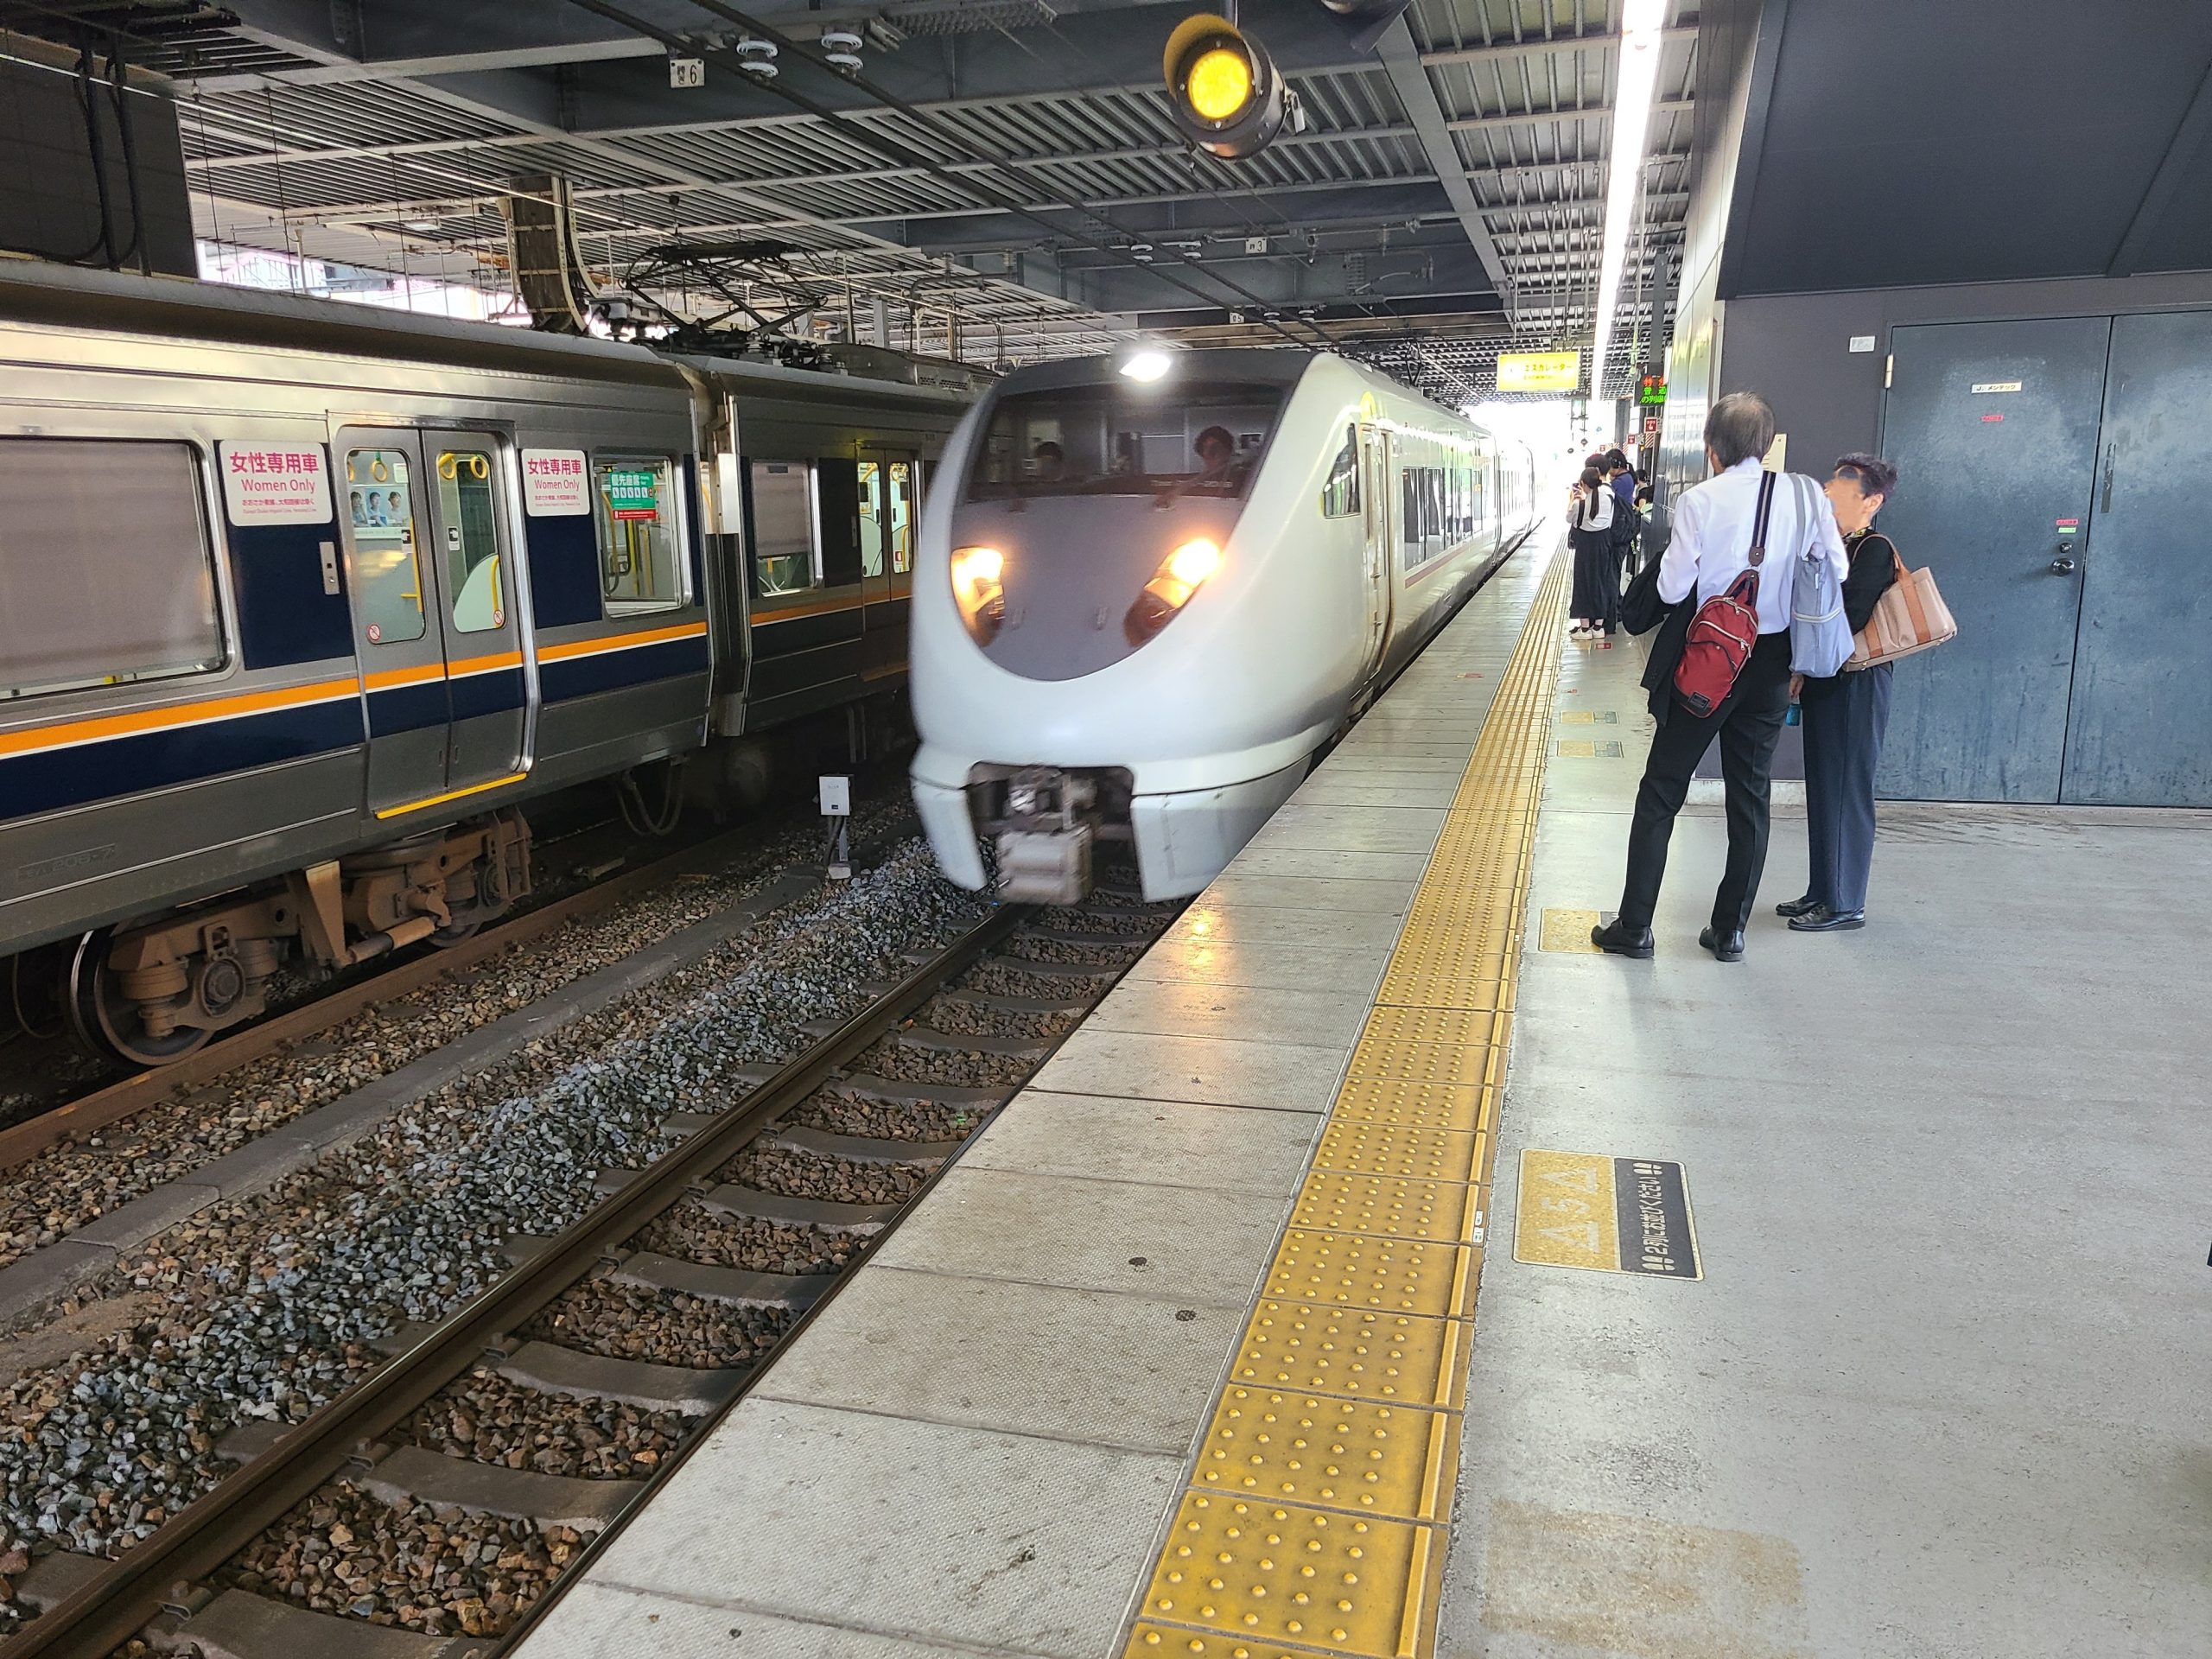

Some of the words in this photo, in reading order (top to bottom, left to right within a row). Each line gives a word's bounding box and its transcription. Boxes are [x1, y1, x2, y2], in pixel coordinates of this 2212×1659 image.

[690, 64, 697, 84] 6
[1257, 240, 1262, 251] 3
[229, 451, 320, 474] 女性専用車
[527, 458, 582, 475] 女性専用車
[241, 479, 288, 492] Women
[289, 478, 315, 494] Only
[534, 479, 563, 490] Women
[563, 479, 580, 492] Only
[1637, 1176, 1669, 1255] 2列にお並びください
